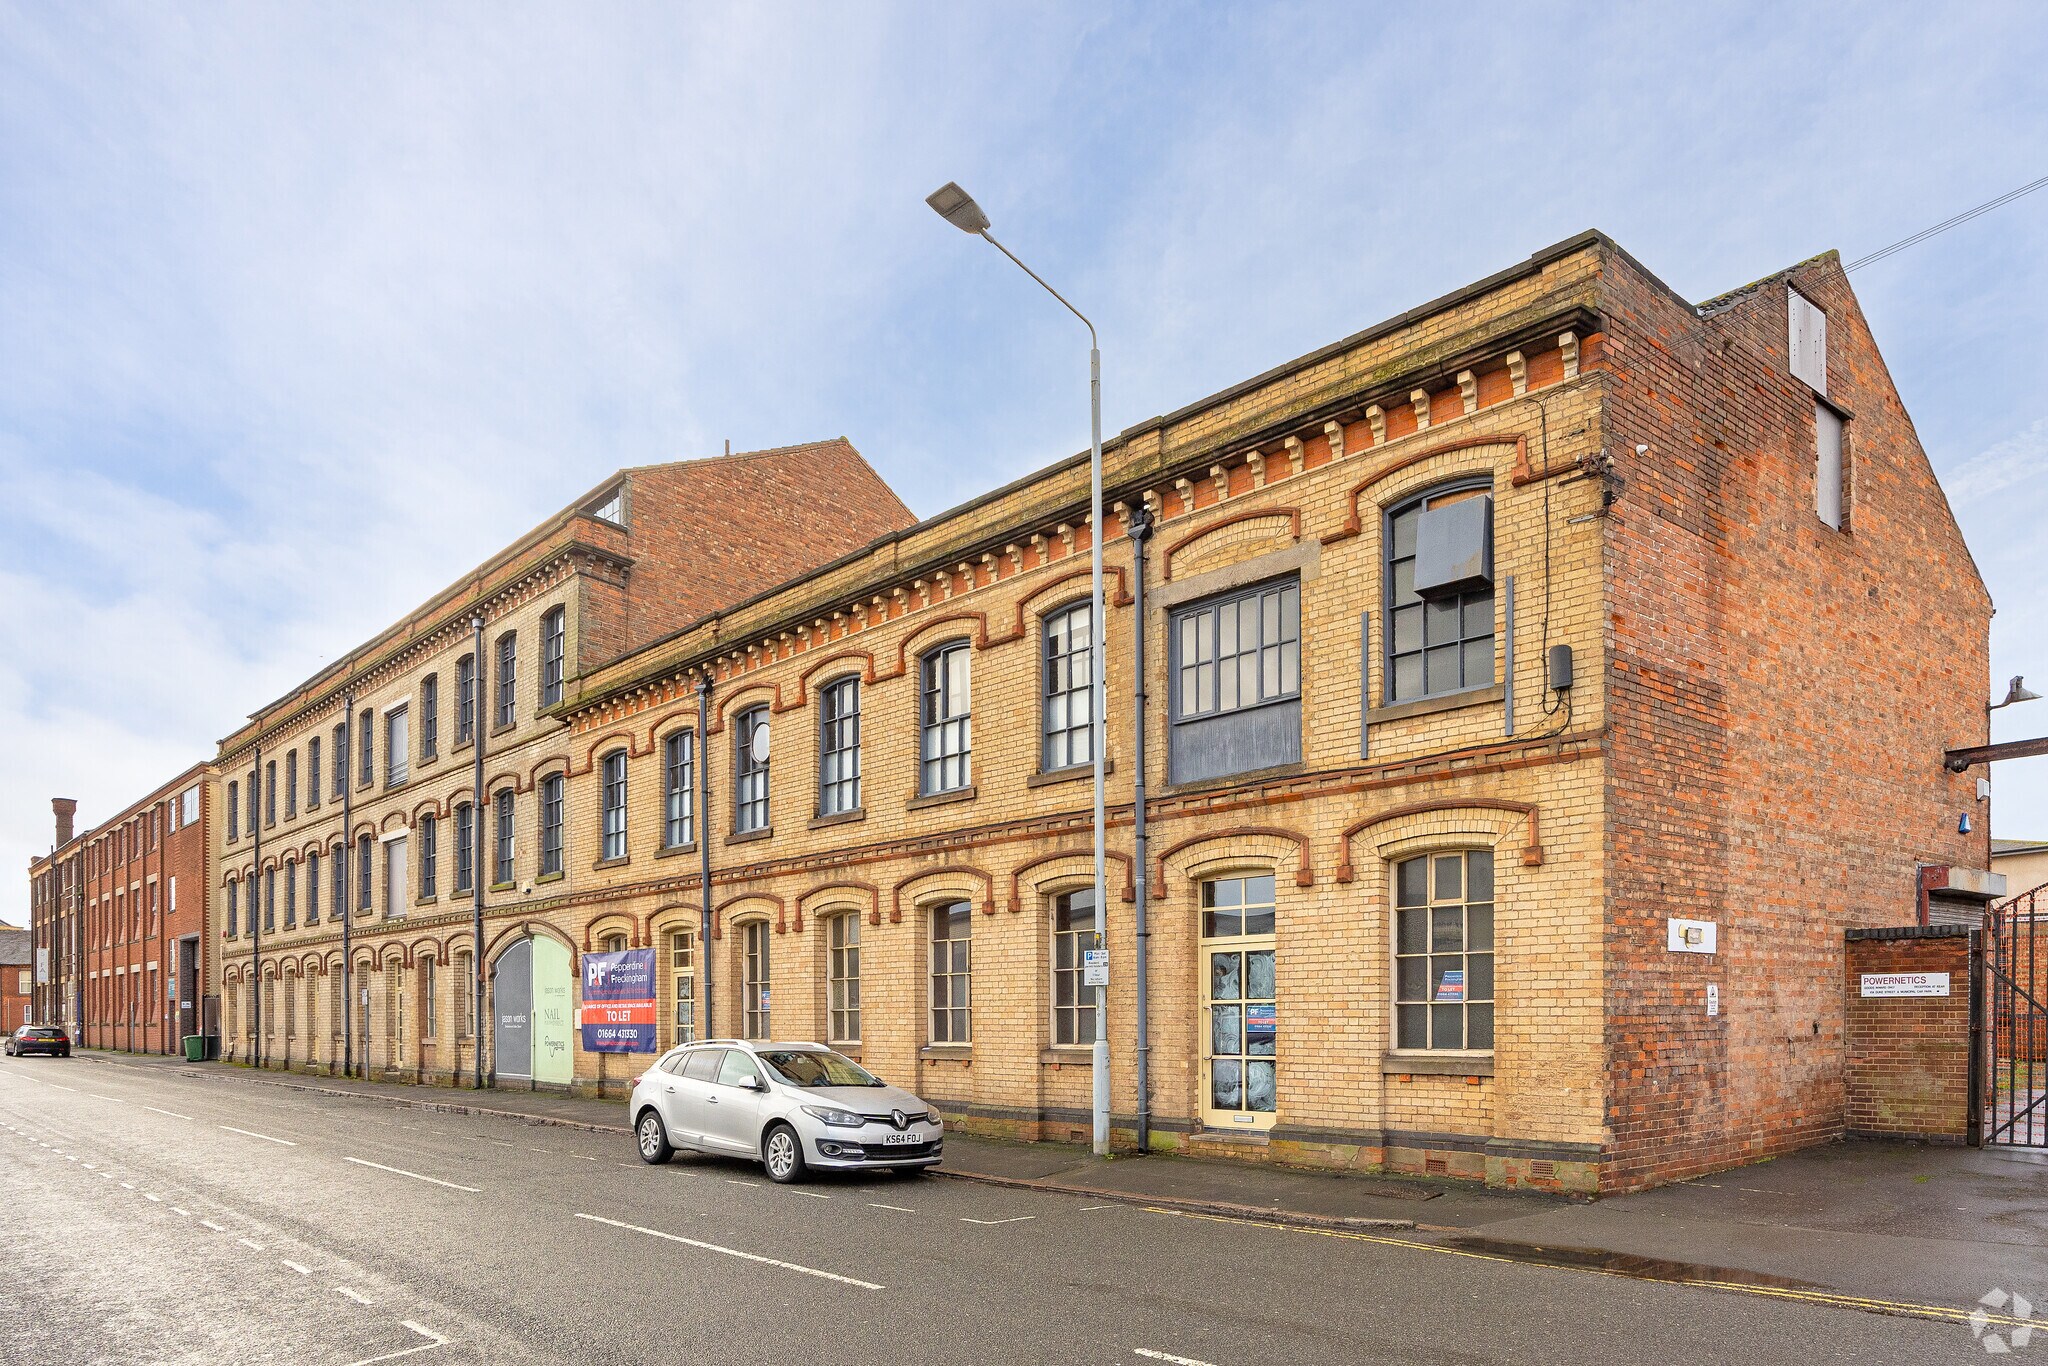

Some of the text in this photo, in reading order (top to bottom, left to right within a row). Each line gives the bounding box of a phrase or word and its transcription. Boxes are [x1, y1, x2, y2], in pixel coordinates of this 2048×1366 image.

[611, 961, 643, 972] Pepperdine
[611, 974, 647, 984] Freckingham
[1864, 976, 1926, 985] POWERNETICS
[513, 1013, 526, 1022] works
[545, 1008, 560, 1020] NAIL
[607, 1010, 631, 1021] TO LET
[598, 1029, 638, 1038] 01664 431330
[886, 1134, 920, 1143] KS64 FOJ
